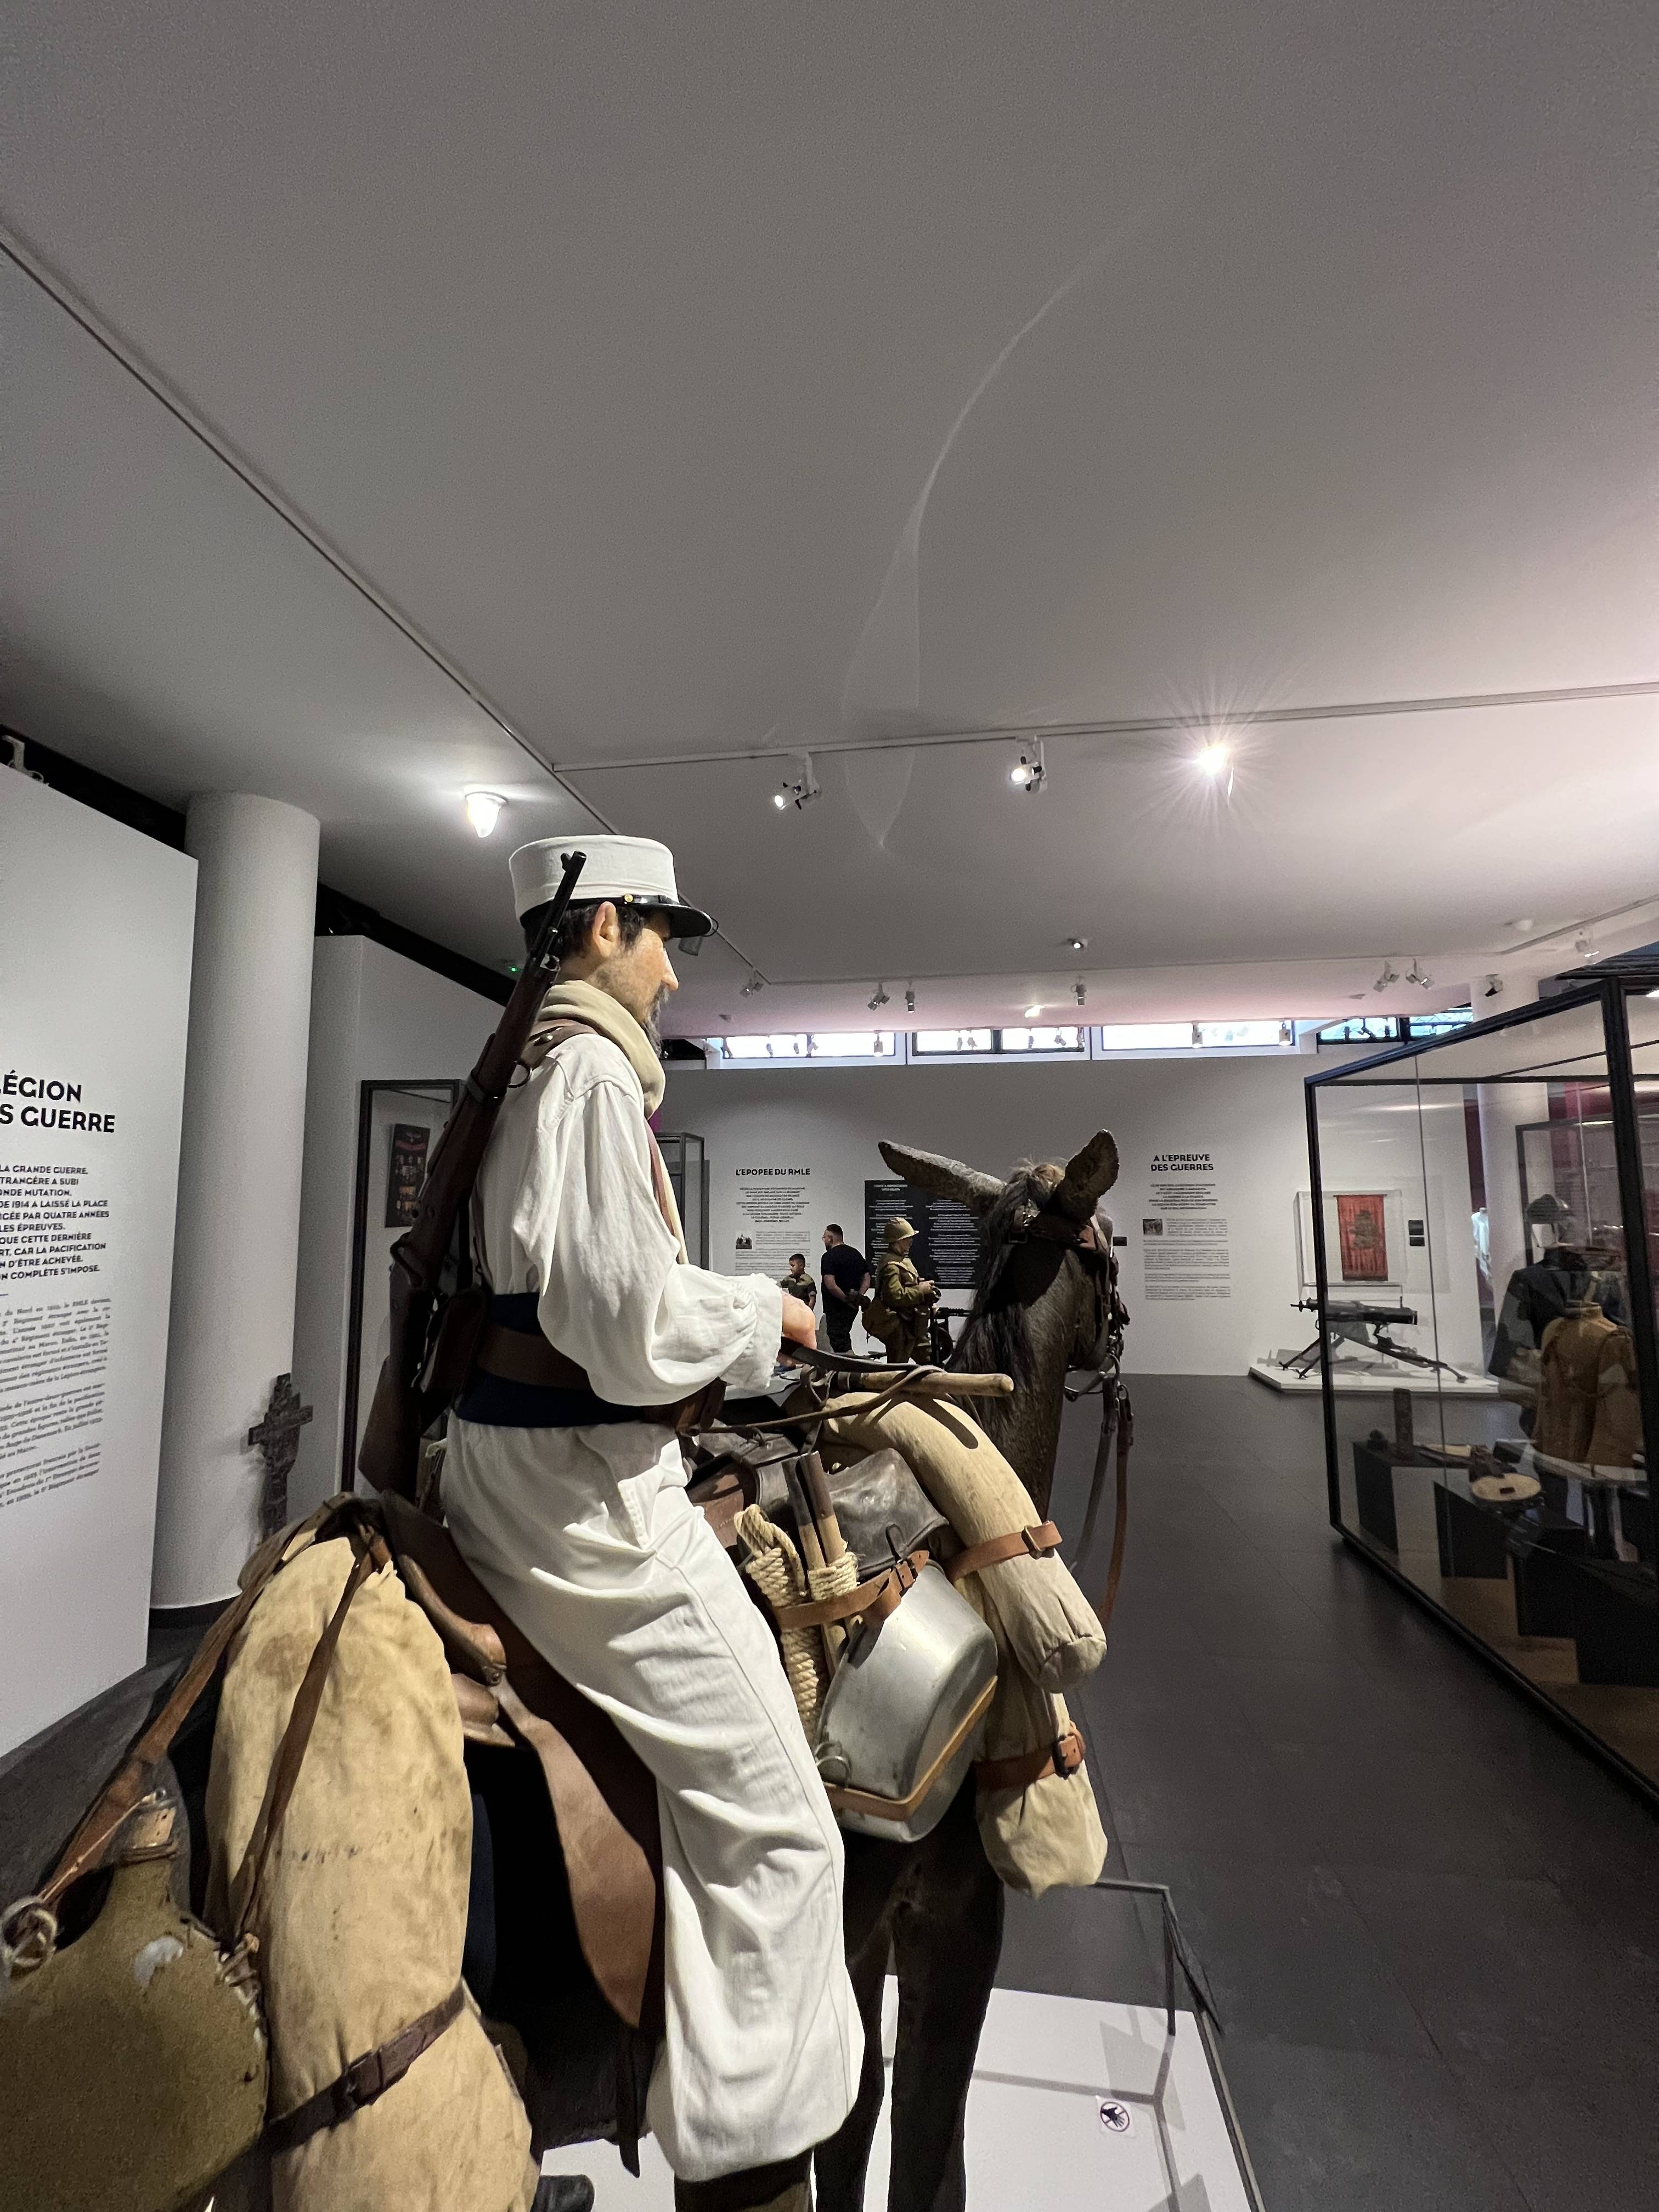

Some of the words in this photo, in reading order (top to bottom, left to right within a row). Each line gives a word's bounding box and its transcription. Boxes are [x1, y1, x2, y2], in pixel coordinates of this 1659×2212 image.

[0, 1070, 82, 1103] ÉGION
[21, 1106, 115, 1133] GUERRE
[13, 1165, 51, 1173] GRANDE
[40, 1199, 69, 1207] LAISSÉ
[22, 1212, 41, 1220] PAR
[43, 1211, 77, 1220] QUATRE
[0, 1236, 19, 1244] QUE
[21, 1235, 49, 1243] CETTE
[14, 1248, 34, 1256] CAR
[49, 1243, 106, 1253] PACIFICATION
